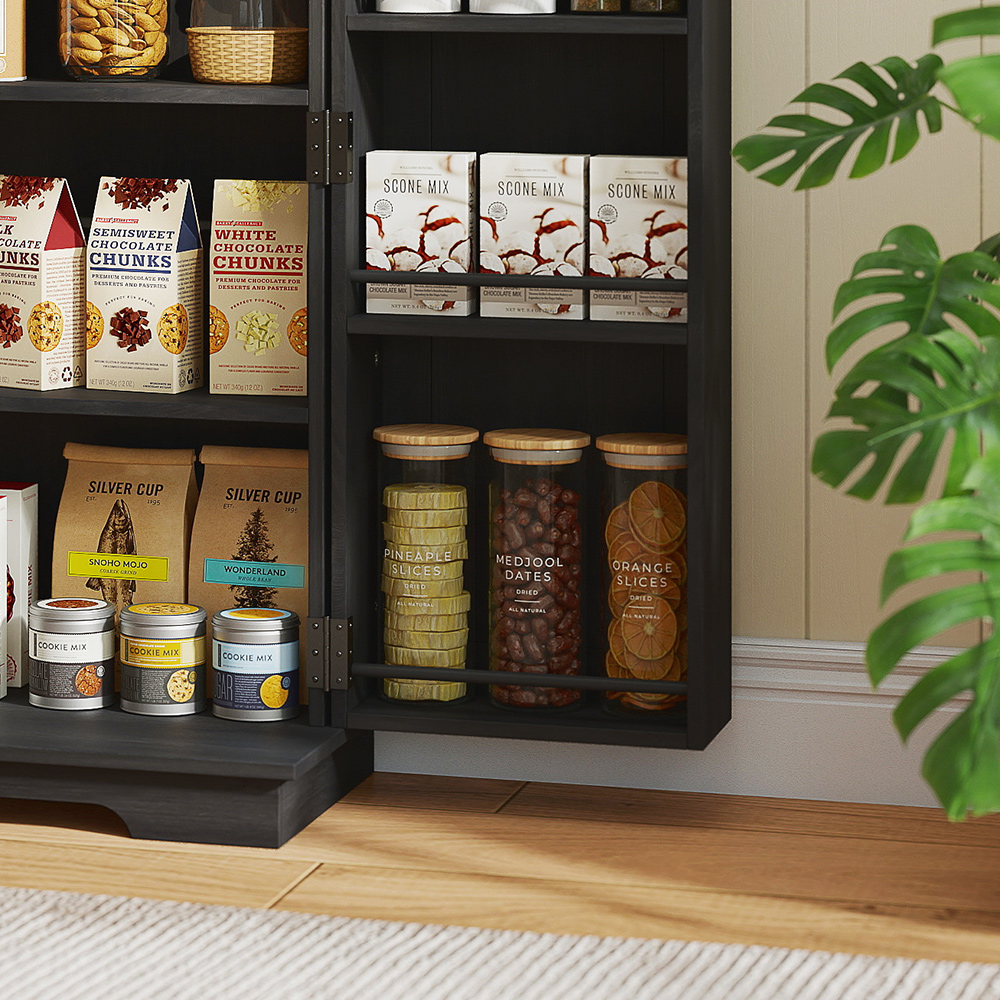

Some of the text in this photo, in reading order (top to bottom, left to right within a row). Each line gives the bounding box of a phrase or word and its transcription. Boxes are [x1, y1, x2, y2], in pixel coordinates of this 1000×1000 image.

[383, 178, 449, 194] SCONE MIX
[498, 181, 564, 197] SCONE MIX
[608, 183, 676, 199] SCONE MIX
[93, 228, 175, 239] SEMISWEET
[215, 230, 276, 240] WHITE
[91, 240, 173, 251] CHOCOLATE
[214, 243, 303, 253] CHOCOLATE
[89, 252, 172, 268] CHUNKS
[213, 256, 303, 270] CHUNKS
[88, 481, 164, 496] SILVER CUP
[225, 488, 302, 504] SILVER CUP
[384, 549, 452, 561] PINEAPLE
[496, 554, 564, 567] MEDJOOL
[89, 559, 148, 569] SNOHO MOJO
[392, 564, 442, 576] SLICES
[612, 560, 673, 573] ORANGE
[224, 565, 287, 576] WONDERLAND
[505, 570, 551, 582] DATES
[617, 575, 668, 587] SLICES
[38, 641, 68, 651] COOKIE
[130, 647, 160, 656] COOKIE
[223, 652, 253, 661] COOKIE
